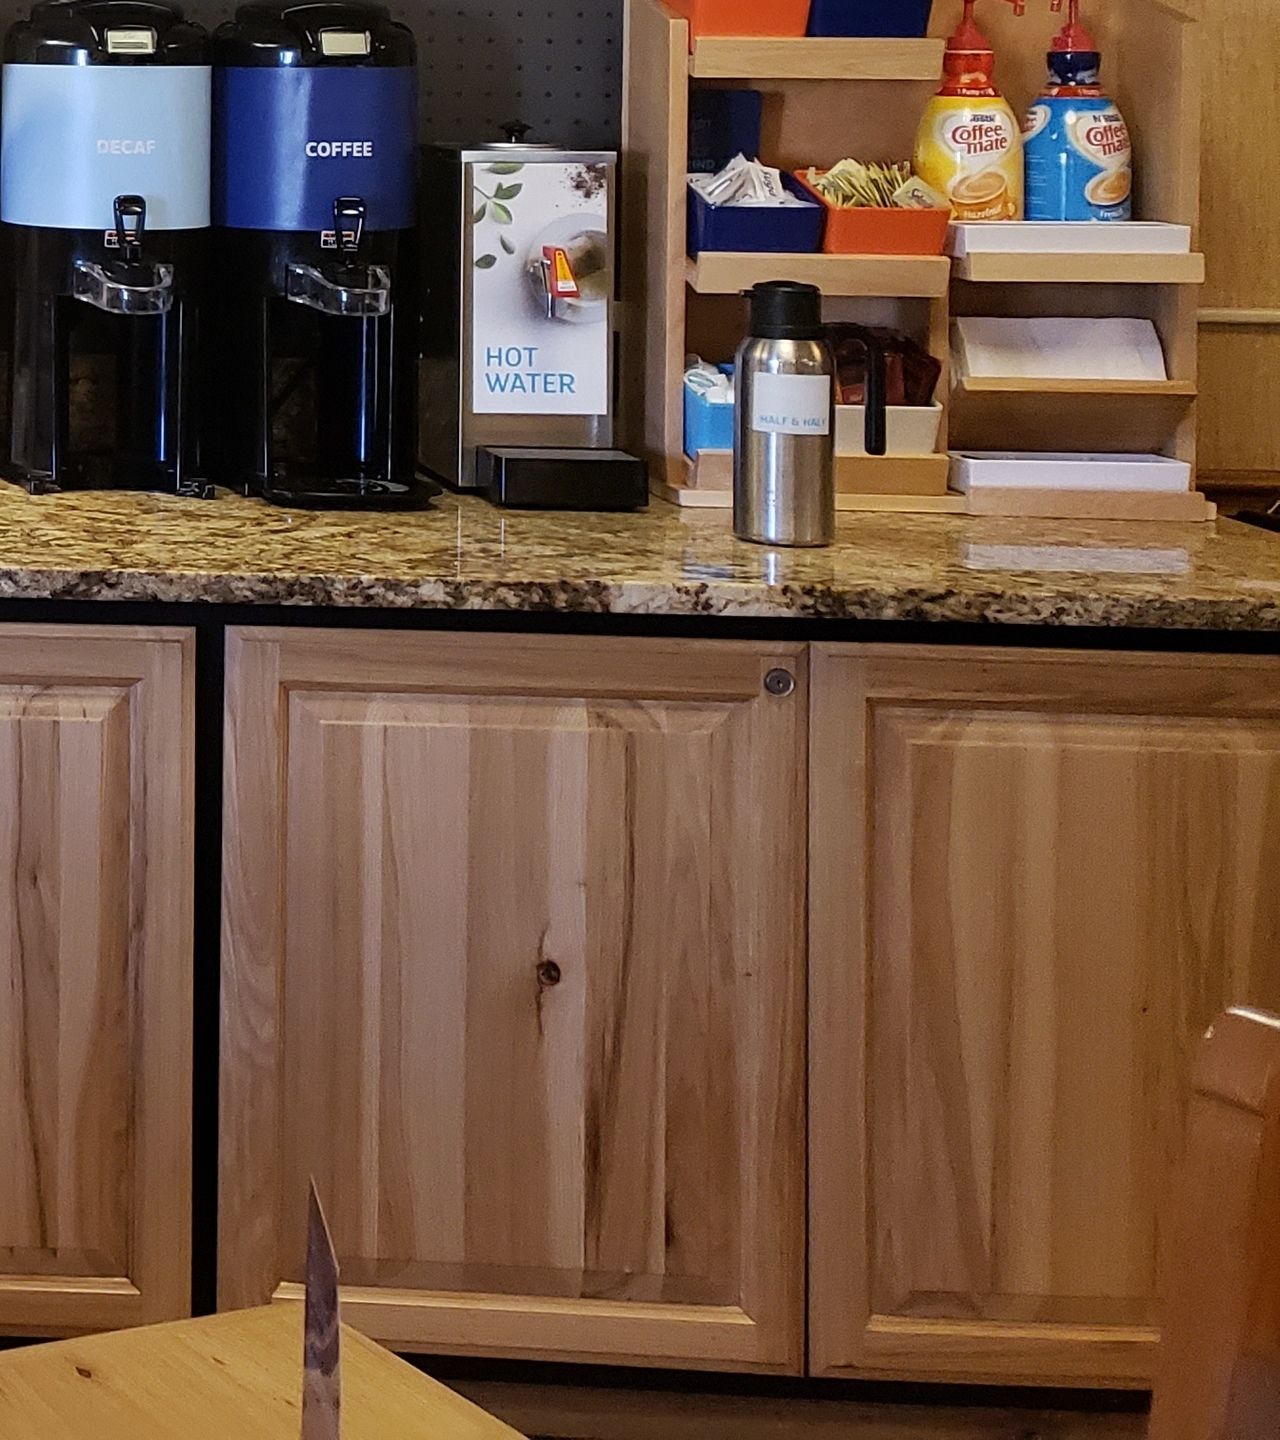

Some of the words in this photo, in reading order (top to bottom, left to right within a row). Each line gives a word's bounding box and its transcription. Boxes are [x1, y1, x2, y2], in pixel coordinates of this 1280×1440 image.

[96, 139, 156, 154] DECAF
[305, 141, 373, 157] COFFEE
[967, 136, 1008, 154] mate
[486, 347, 539, 367] HOT
[485, 373, 576, 394] WATER
[760, 416, 787, 426] HALF
